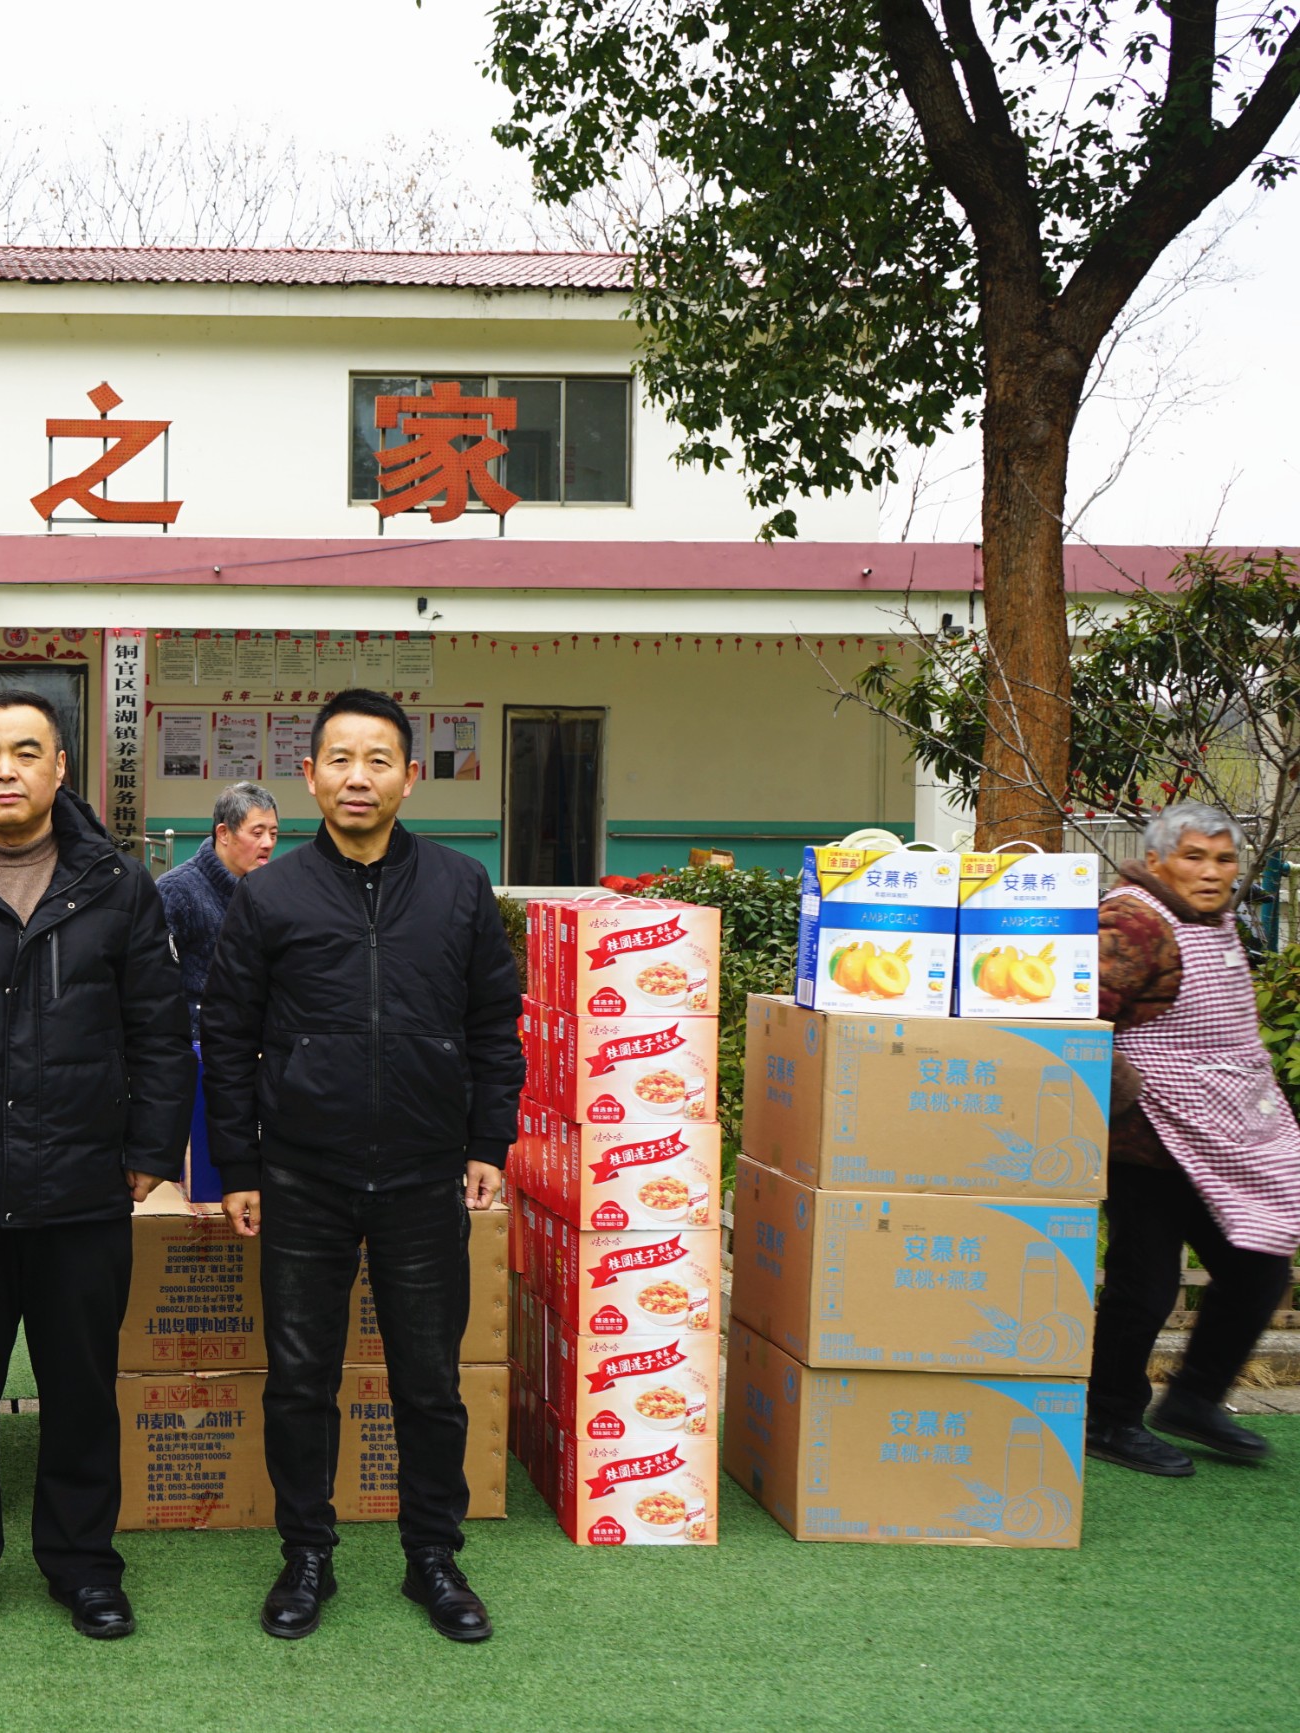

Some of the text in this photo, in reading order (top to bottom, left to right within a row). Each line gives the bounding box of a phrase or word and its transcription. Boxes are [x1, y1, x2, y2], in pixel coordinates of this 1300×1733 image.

[866, 870, 918, 889] 安慕希
[1004, 873, 1056, 891] 安慕希
[589, 918, 620, 928] 娃哈哈
[588, 1025, 620, 1036] 娃哈哈
[919, 1057, 997, 1087] 安慕希
[908, 1092, 1004, 1115] 黄桃+燕麦
[591, 1132, 624, 1143] 娃哈哈
[589, 1236, 622, 1247] 娃哈哈
[904, 1235, 982, 1264] 安慕希
[893, 1268, 988, 1291] 黄桃+燕麦
[144, 1316, 254, 1335] 丹麦风味曲奇饼干
[588, 1342, 620, 1353] 娃哈哈
[136, 1411, 246, 1429] 丹麦风奇饼干
[350, 1404, 394, 1419] 丹麦风
[890, 1410, 967, 1438] 安慕希
[361, 1433, 396, 1441] 食品生产
[588, 1447, 620, 1458] 娃哈哈
[879, 1443, 972, 1465] 黄桃+燕麦
